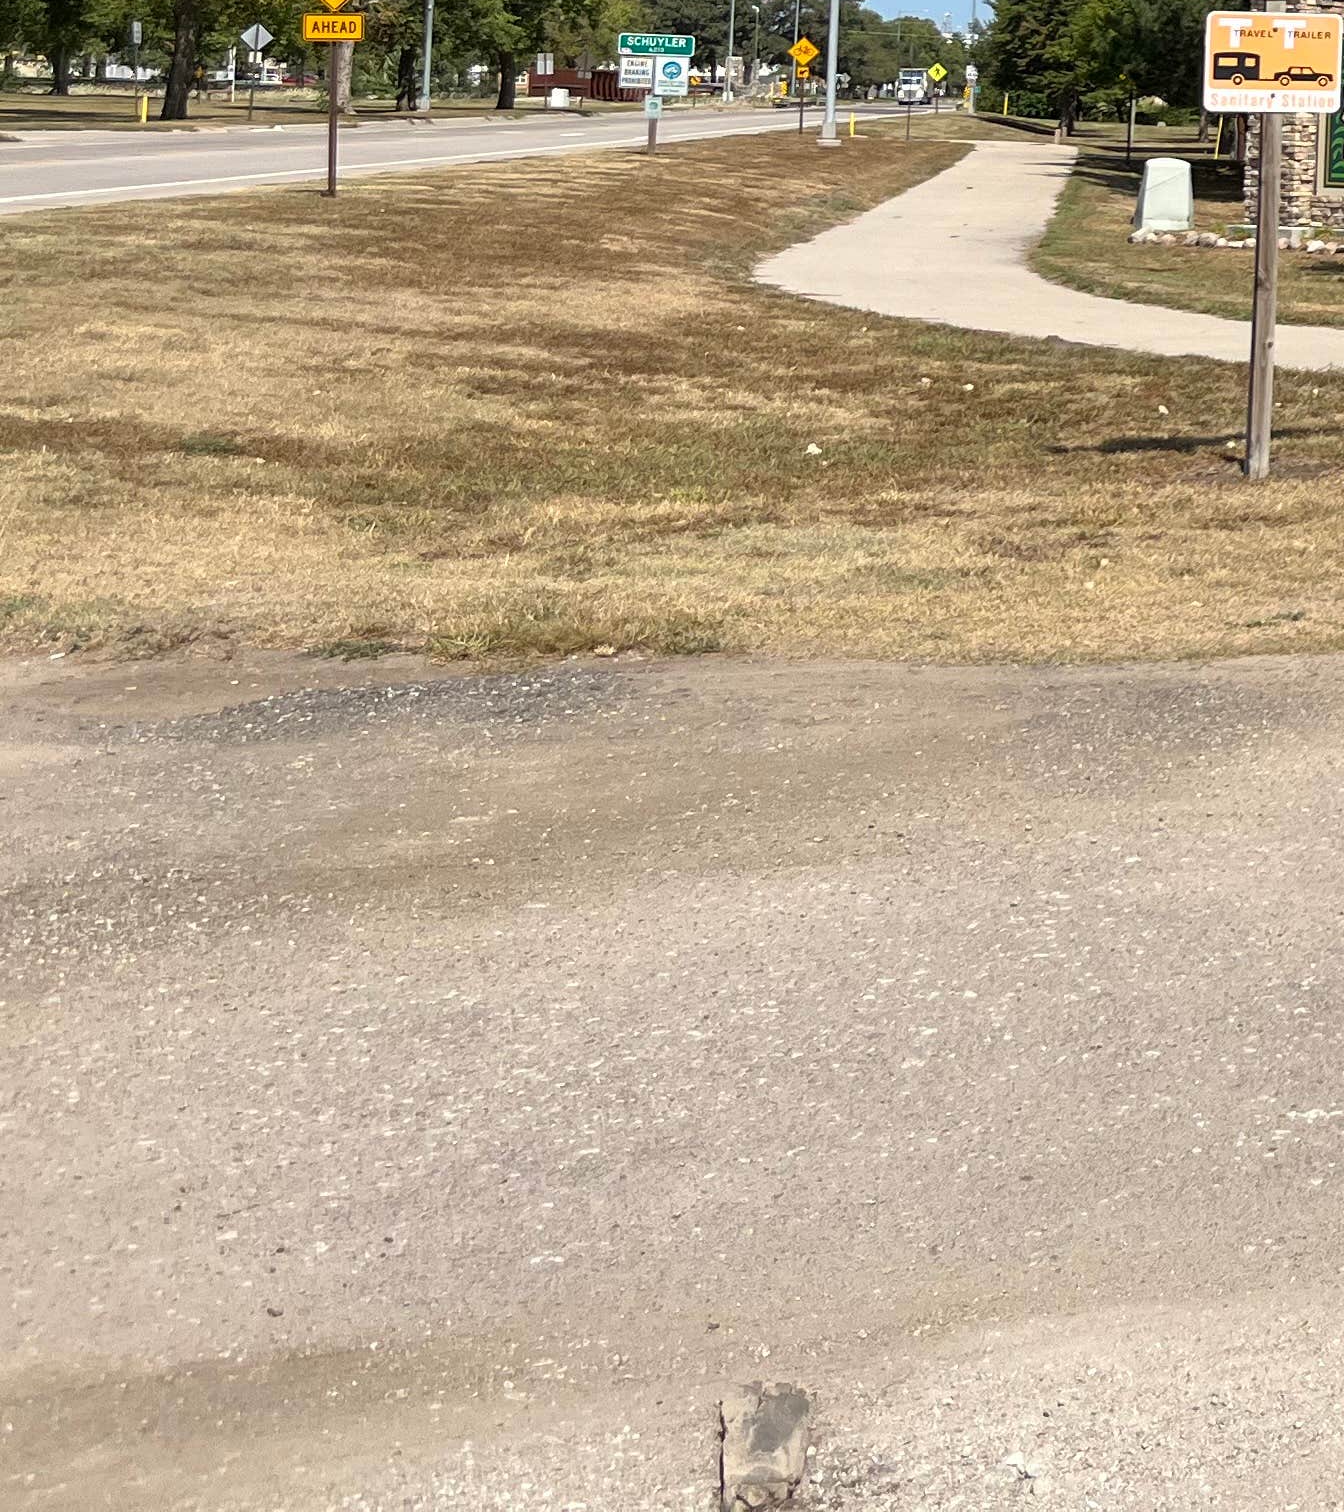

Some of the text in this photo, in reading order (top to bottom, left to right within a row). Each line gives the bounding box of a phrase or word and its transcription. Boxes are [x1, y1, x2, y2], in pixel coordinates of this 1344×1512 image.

[312, 21, 357, 33] AHEAD
[1234, 29, 1332, 40] TRAVEL TRAILER
[627, 36, 687, 48] SCHUYLER
[1211, 93, 1335, 108] Sanitary Station
